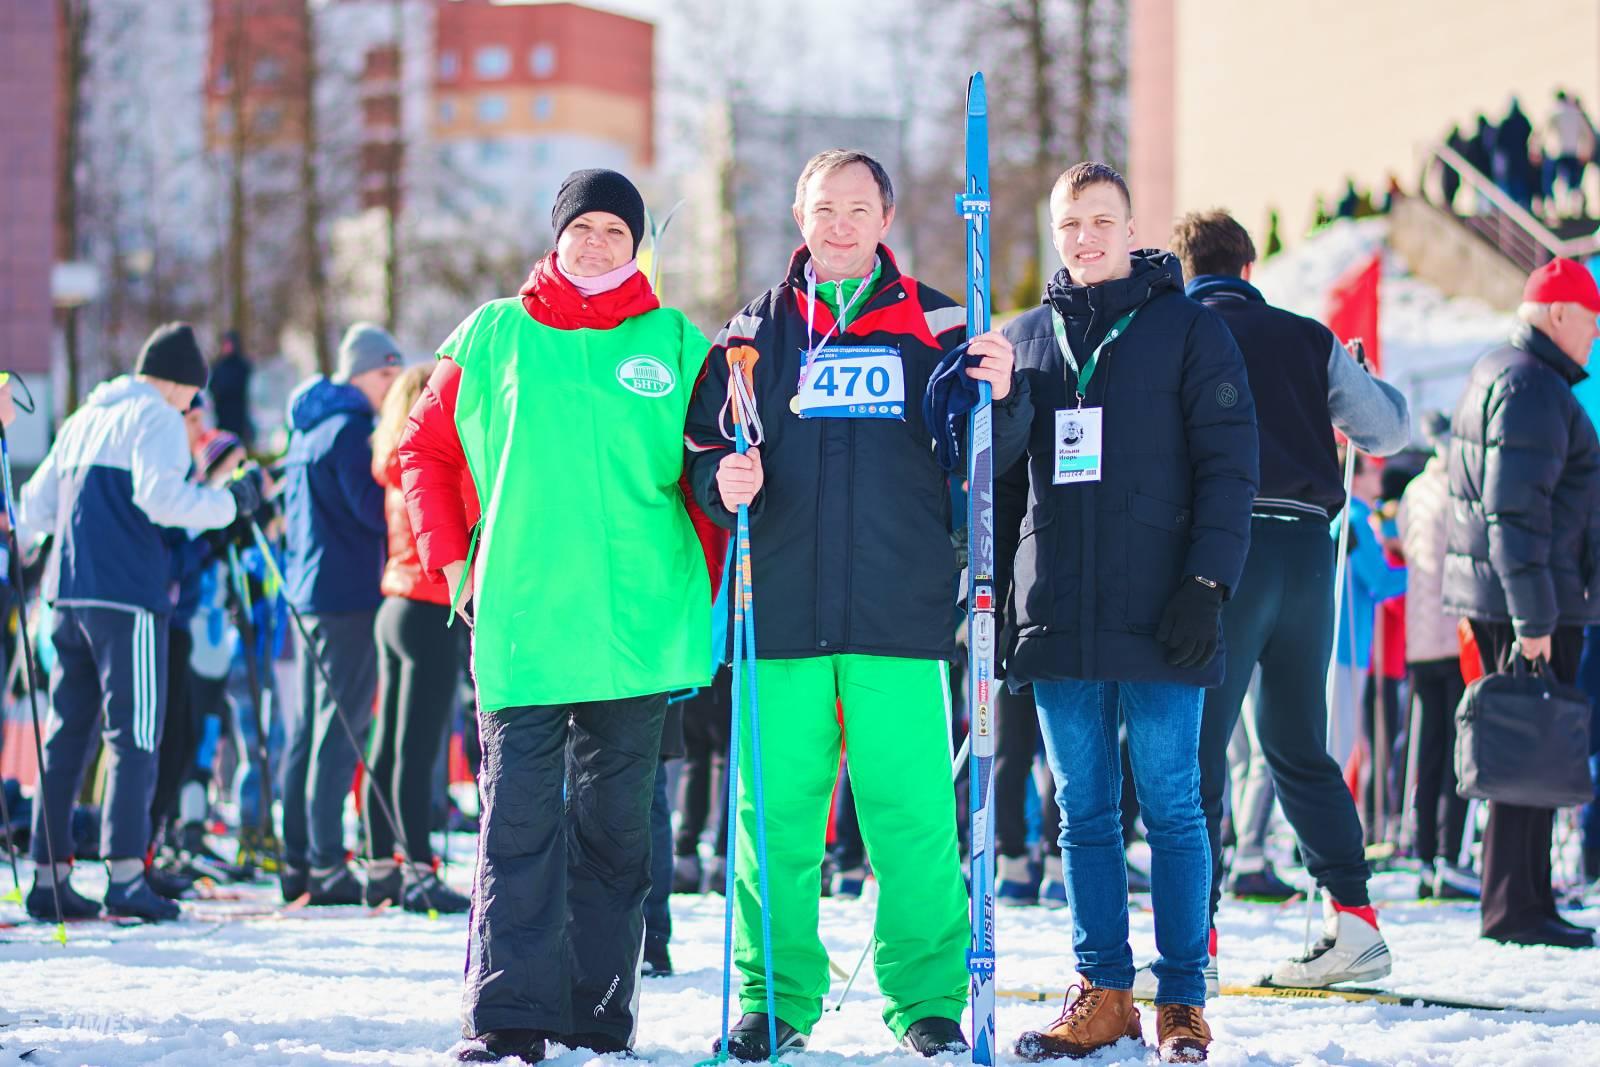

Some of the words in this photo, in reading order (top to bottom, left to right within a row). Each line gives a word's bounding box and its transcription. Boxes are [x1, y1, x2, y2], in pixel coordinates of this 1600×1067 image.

[633, 378, 666, 392] БНТУ
[813, 366, 890, 397] 470
[984, 894, 993, 981] CUISER
